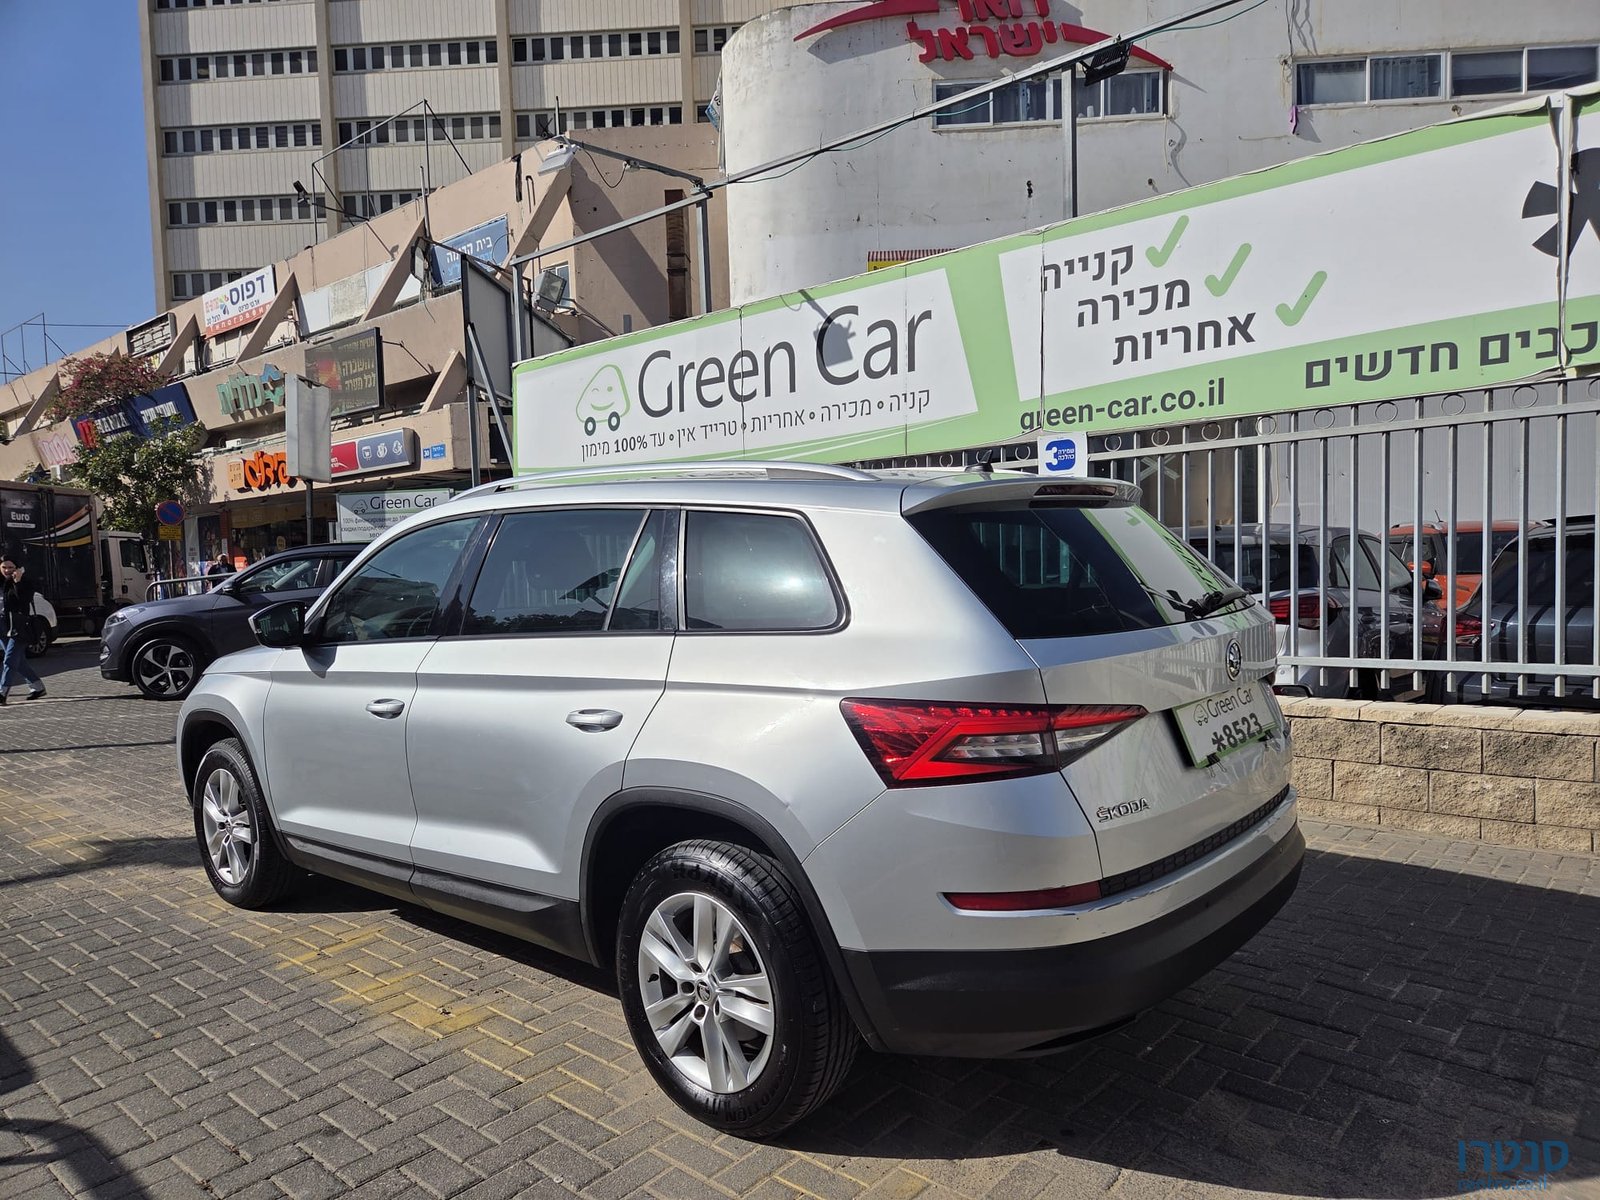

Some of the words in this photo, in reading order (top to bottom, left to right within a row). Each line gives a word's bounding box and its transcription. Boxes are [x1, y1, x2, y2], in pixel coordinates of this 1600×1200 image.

[906, 20, 1058, 63] ישראל
[476, 236, 493, 252] בית
[1041, 244, 1134, 293] קנייה
[229, 274, 265, 305] דפוס
[1077, 279, 1190, 328] מכירה
[1112, 312, 1256, 366] אחריות
[637, 339, 797, 419] Green
[815, 304, 932, 386] Car
[1305, 341, 1459, 389] חדשים
[820, 397, 872, 423] מכירה
[888, 388, 931, 414] קניה
[1020, 377, 1225, 435] green-car.co.il
[699, 418, 738, 440] טרייד
[749, 408, 806, 433] אחריות
[613, 435, 648, 454] 100%
[650, 430, 666, 447] עד
[675, 425, 696, 450] אין
[581, 439, 611, 463] מימון
[369, 496, 413, 510] Green
[414, 494, 438, 508] Car
[11, 511, 30, 522] Euro
[1206, 694, 1240, 718] Green
[1237, 687, 1253, 704] Car
[1096, 797, 1150, 823] ŠKODA
